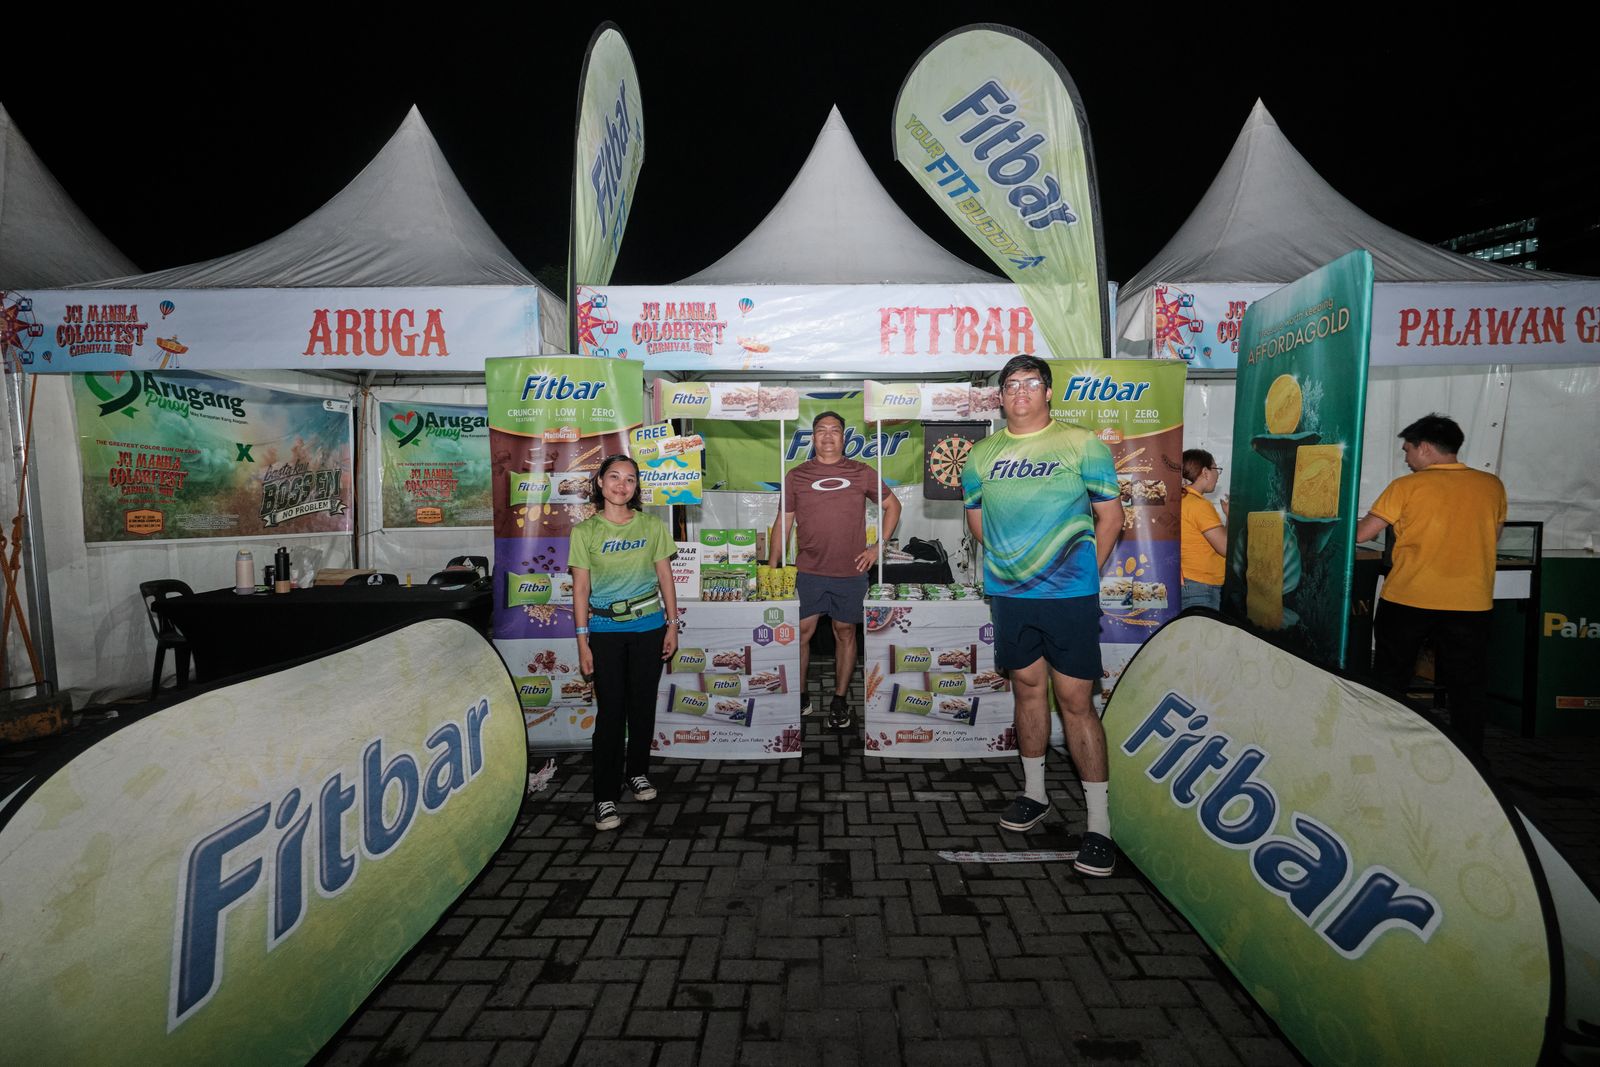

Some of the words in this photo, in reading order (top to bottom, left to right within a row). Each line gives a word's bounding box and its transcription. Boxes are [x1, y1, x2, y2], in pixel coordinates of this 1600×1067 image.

[903, 113, 946, 161] YOUR
[591, 78, 632, 241] Fitbar
[940, 78, 1077, 231] Fitbar
[924, 151, 981, 199] FIT
[955, 195, 1027, 258] BUDDY
[63, 304, 84, 324] JCI
[87, 304, 139, 324] MANILA
[640, 302, 660, 321] JCI
[665, 302, 718, 321] MANILA
[302, 308, 450, 357] ARUGA
[632, 320, 728, 345] COLORFEST
[878, 304, 1036, 356] FITBAR
[1396, 306, 1567, 346] PALAWAN
[56, 322, 149, 348] COLORFEST
[1246, 306, 1350, 366] AFFORDAGOLD
[69, 343, 112, 357] CARNIVAL
[646, 342, 692, 356] CARNIVAL
[143, 371, 247, 418] Arugang
[520, 374, 606, 402] Fitbar
[1062, 374, 1151, 402] Fitbar
[145, 390, 190, 419] Pinoy
[671, 393, 709, 406] Fitbar
[881, 393, 919, 406] Fitbar
[507, 408, 544, 417] CRUNCHY
[555, 407, 577, 417] LOW
[591, 408, 616, 417] ZERO
[1049, 408, 1087, 418] CRUNCHY
[1097, 408, 1120, 418] LOW
[1135, 409, 1159, 418] ZERO
[425, 425, 461, 441] Pinoy
[636, 425, 668, 442] FREE
[236, 443, 255, 462] X
[639, 447, 658, 456] Fitbar
[786, 427, 910, 462] Fbar
[116, 450, 132, 468] JCI
[135, 452, 181, 470] MANILA
[989, 456, 1061, 480] Fitbar
[109, 467, 189, 490] COLORFEST
[639, 470, 701, 482] Fitbarkada
[260, 472, 313, 517] BOSS
[517, 482, 550, 492] Fitbar
[282, 509, 294, 519] NO
[295, 500, 329, 515] PROBLEM
[601, 537, 648, 554] Fitbar
[518, 583, 550, 593] Fitbar
[712, 585, 734, 594] Fitbar
[768, 609, 779, 620] NO
[758, 628, 769, 638] NO
[779, 628, 790, 638] 90
[984, 627, 994, 637] NO
[679, 655, 704, 664] Fitbar
[903, 654, 929, 663] Fitbar
[519, 684, 550, 695] Fitbar
[713, 680, 739, 689] Fitbar
[938, 680, 964, 689] Fitbar
[681, 696, 706, 708] Fitbar
[904, 695, 930, 707] Fitbar
[675, 733, 706, 741] MultiGrain
[897, 732, 929, 741] MultiGrain
[1100, 691, 1441, 957] Fitbar
[169, 696, 491, 1030] Fitbar
